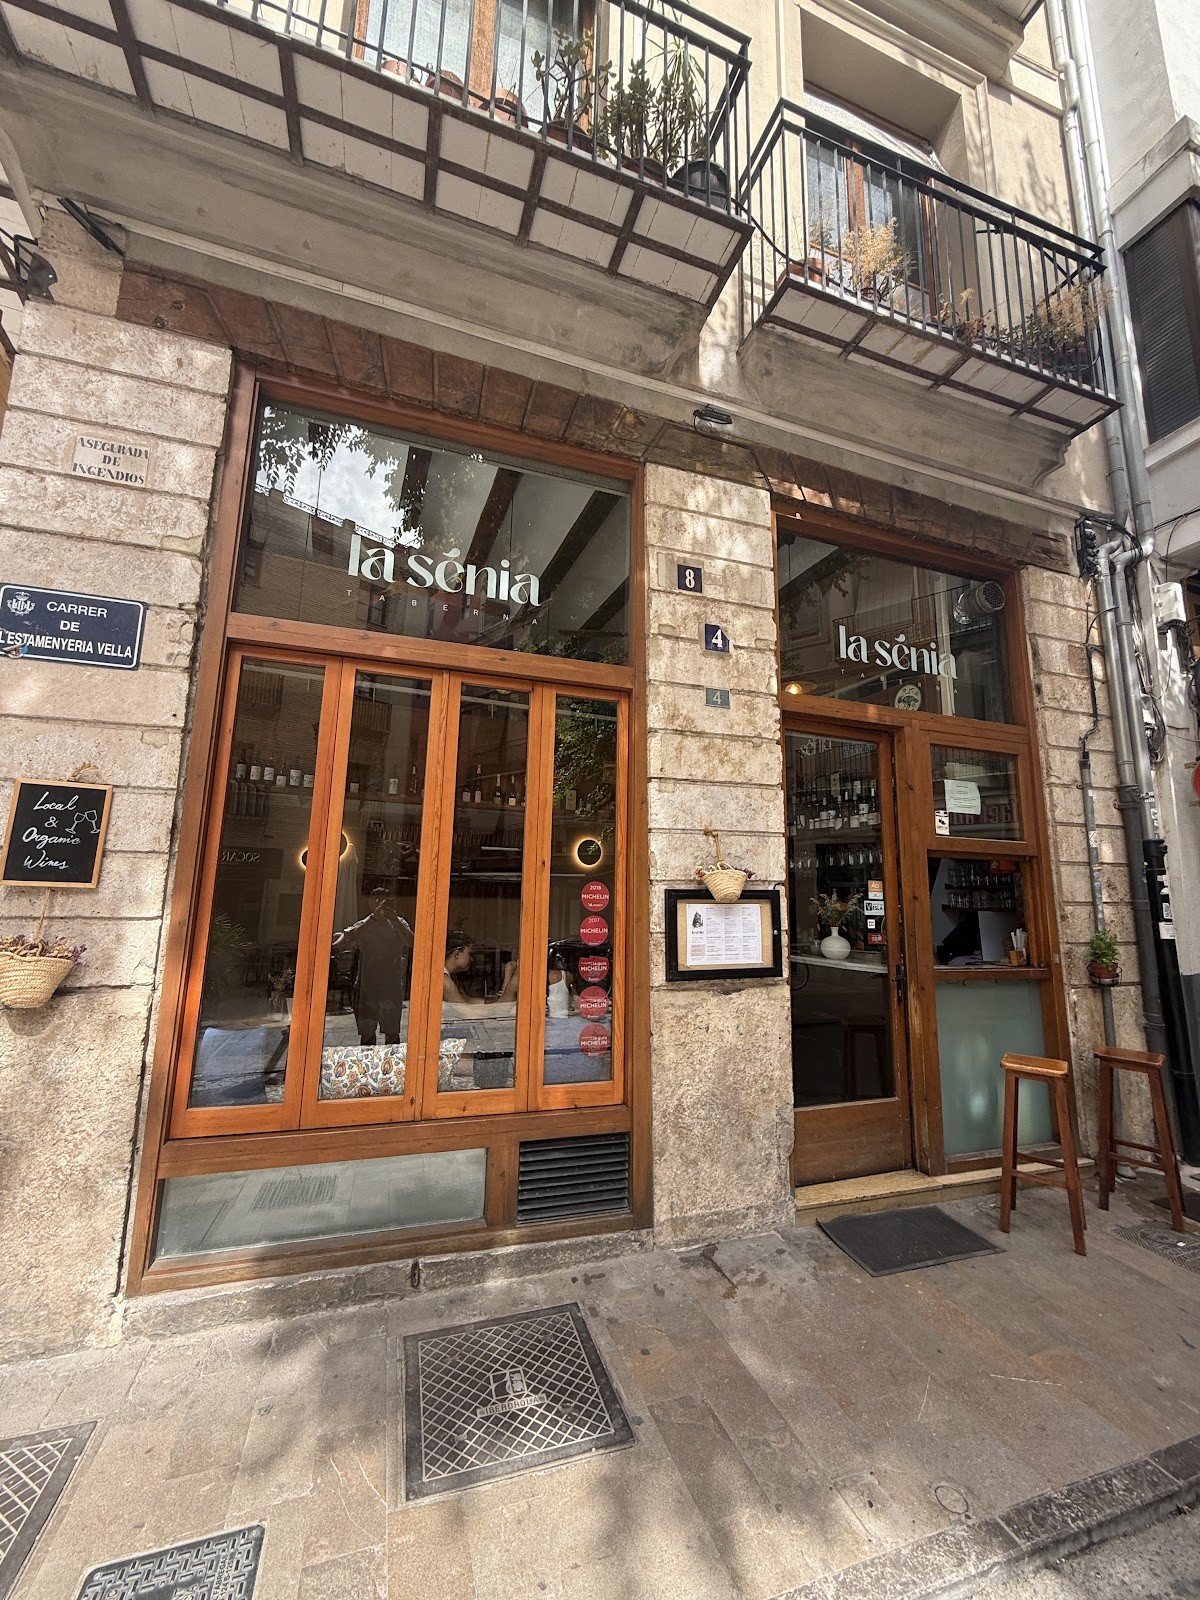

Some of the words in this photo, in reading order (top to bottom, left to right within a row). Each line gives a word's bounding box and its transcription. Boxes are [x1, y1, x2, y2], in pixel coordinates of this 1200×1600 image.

[80, 437, 149, 459] ASEGURADA
[102, 455, 121, 466] DE
[348, 534, 396, 583] la
[406, 547, 541, 607] sénia
[685, 568, 695, 588] 8
[46, 601, 108, 618] CARRER
[346, 590, 538, 625] TABERNA
[60, 620, 80, 632] DE
[0, 630, 94, 654] L'ESTAMENYERIA
[97, 642, 132, 658] VELLA
[711, 628, 723, 648] 4
[838, 625, 869, 664] la
[875, 634, 958, 679] sénia
[713, 691, 722, 705] 4
[33, 791, 79, 811] Local
[44, 816, 59, 828] &
[22, 827, 81, 849] Organic
[23, 850, 69, 869] Wines
[485, 1396, 540, 1415] IBERDROLA
